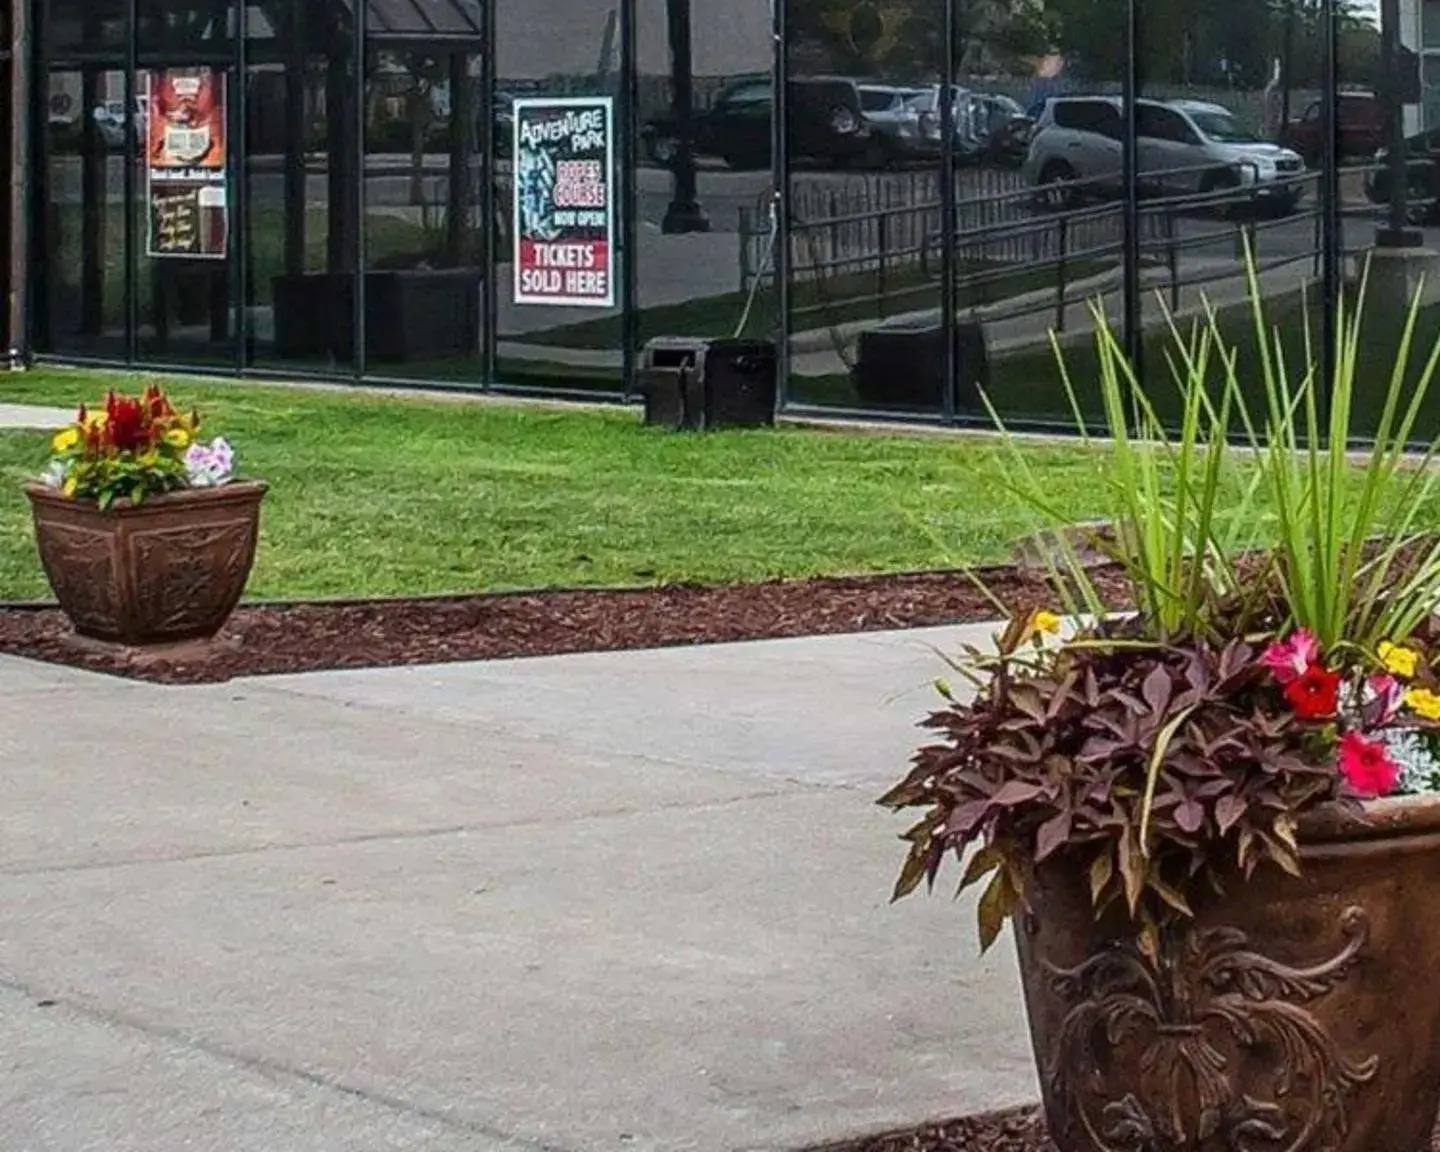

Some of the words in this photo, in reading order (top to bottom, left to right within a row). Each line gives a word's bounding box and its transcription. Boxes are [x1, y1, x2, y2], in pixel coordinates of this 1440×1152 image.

[520, 108, 603, 151] ADVENTURE
[571, 129, 606, 154] PARK
[553, 183, 606, 207] COURSE
[532, 243, 595, 268] TICKETS
[521, 269, 561, 293] SOLD
[565, 269, 606, 294] HERE
